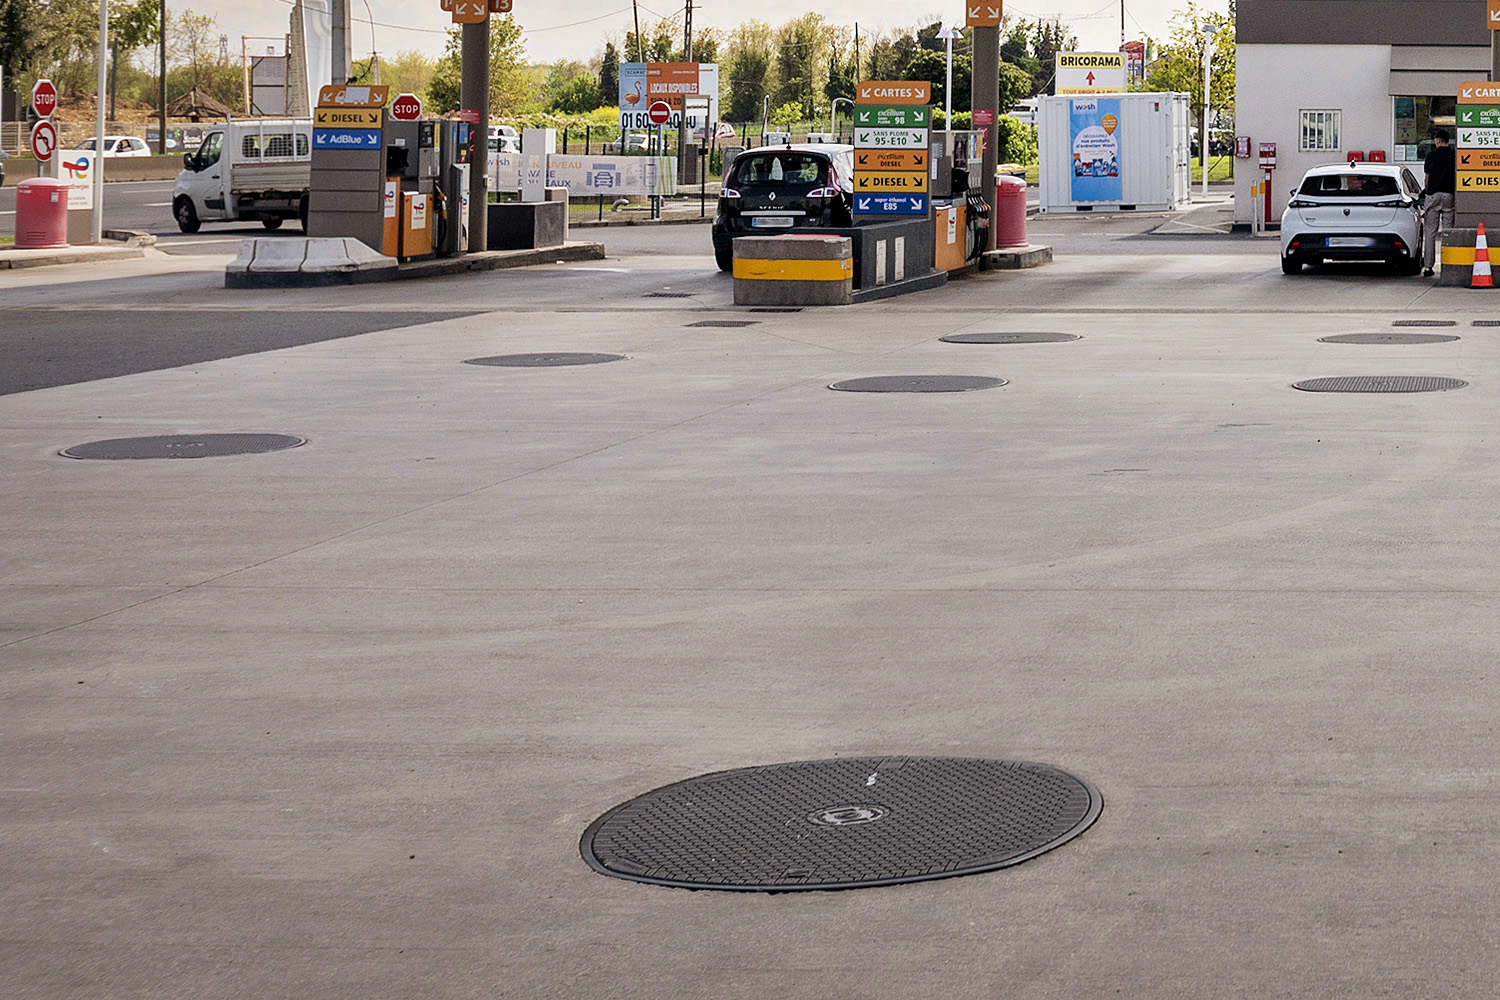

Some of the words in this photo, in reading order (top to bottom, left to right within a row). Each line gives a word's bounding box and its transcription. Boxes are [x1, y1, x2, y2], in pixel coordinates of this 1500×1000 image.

[1060, 56, 1121, 67] BRICORAMA
[873, 87, 913, 98] CARTES
[35, 94, 55, 105] STOP
[394, 104, 419, 114] STOP
[1075, 103, 1096, 111] wash
[332, 114, 363, 123] DIESEL
[622, 112, 633, 129] 01
[635, 112, 649, 129] 60
[875, 137, 907, 145] 95-E10
[873, 178, 908, 186] DIESEL
